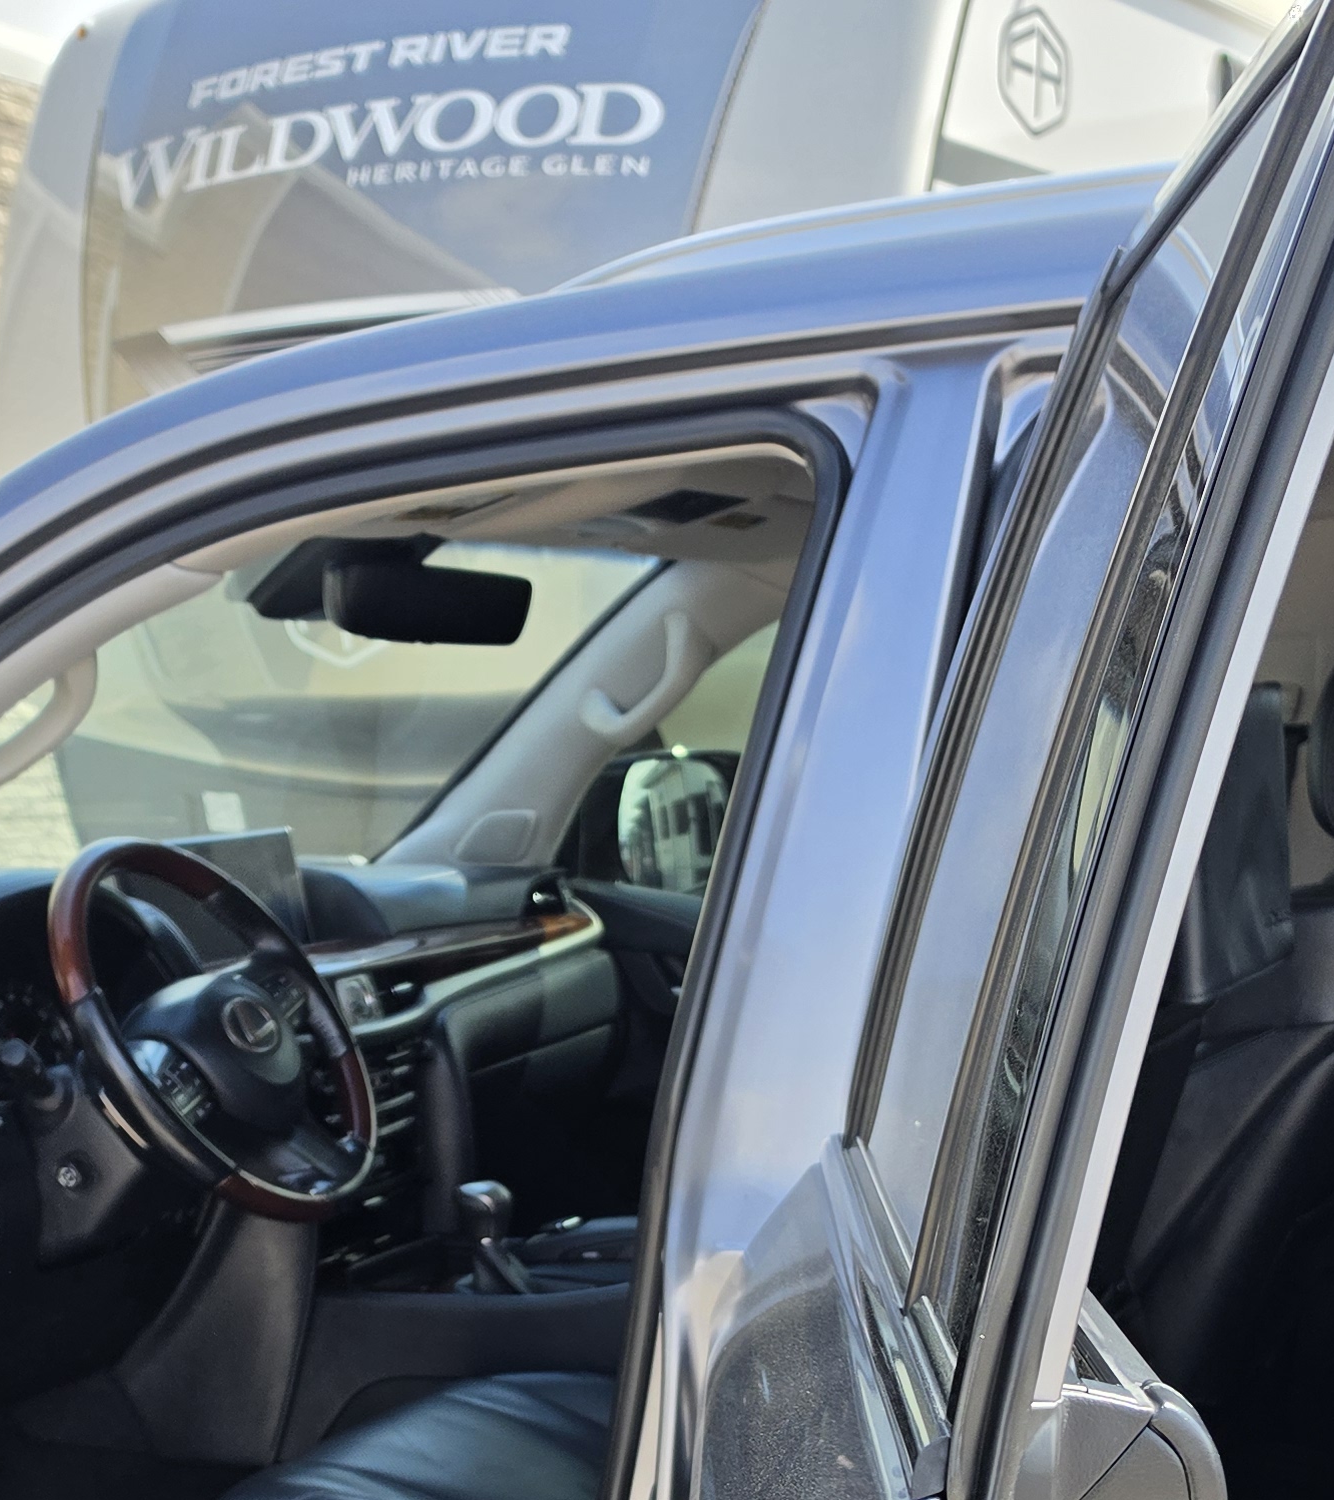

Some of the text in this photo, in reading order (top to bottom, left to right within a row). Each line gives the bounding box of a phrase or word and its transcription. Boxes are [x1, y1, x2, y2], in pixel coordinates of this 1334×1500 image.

[186, 23, 571, 109] FOREST RIVER
[116, 82, 665, 212] WILDWOOD
[345, 153, 651, 188] HERITAGE GLEN
